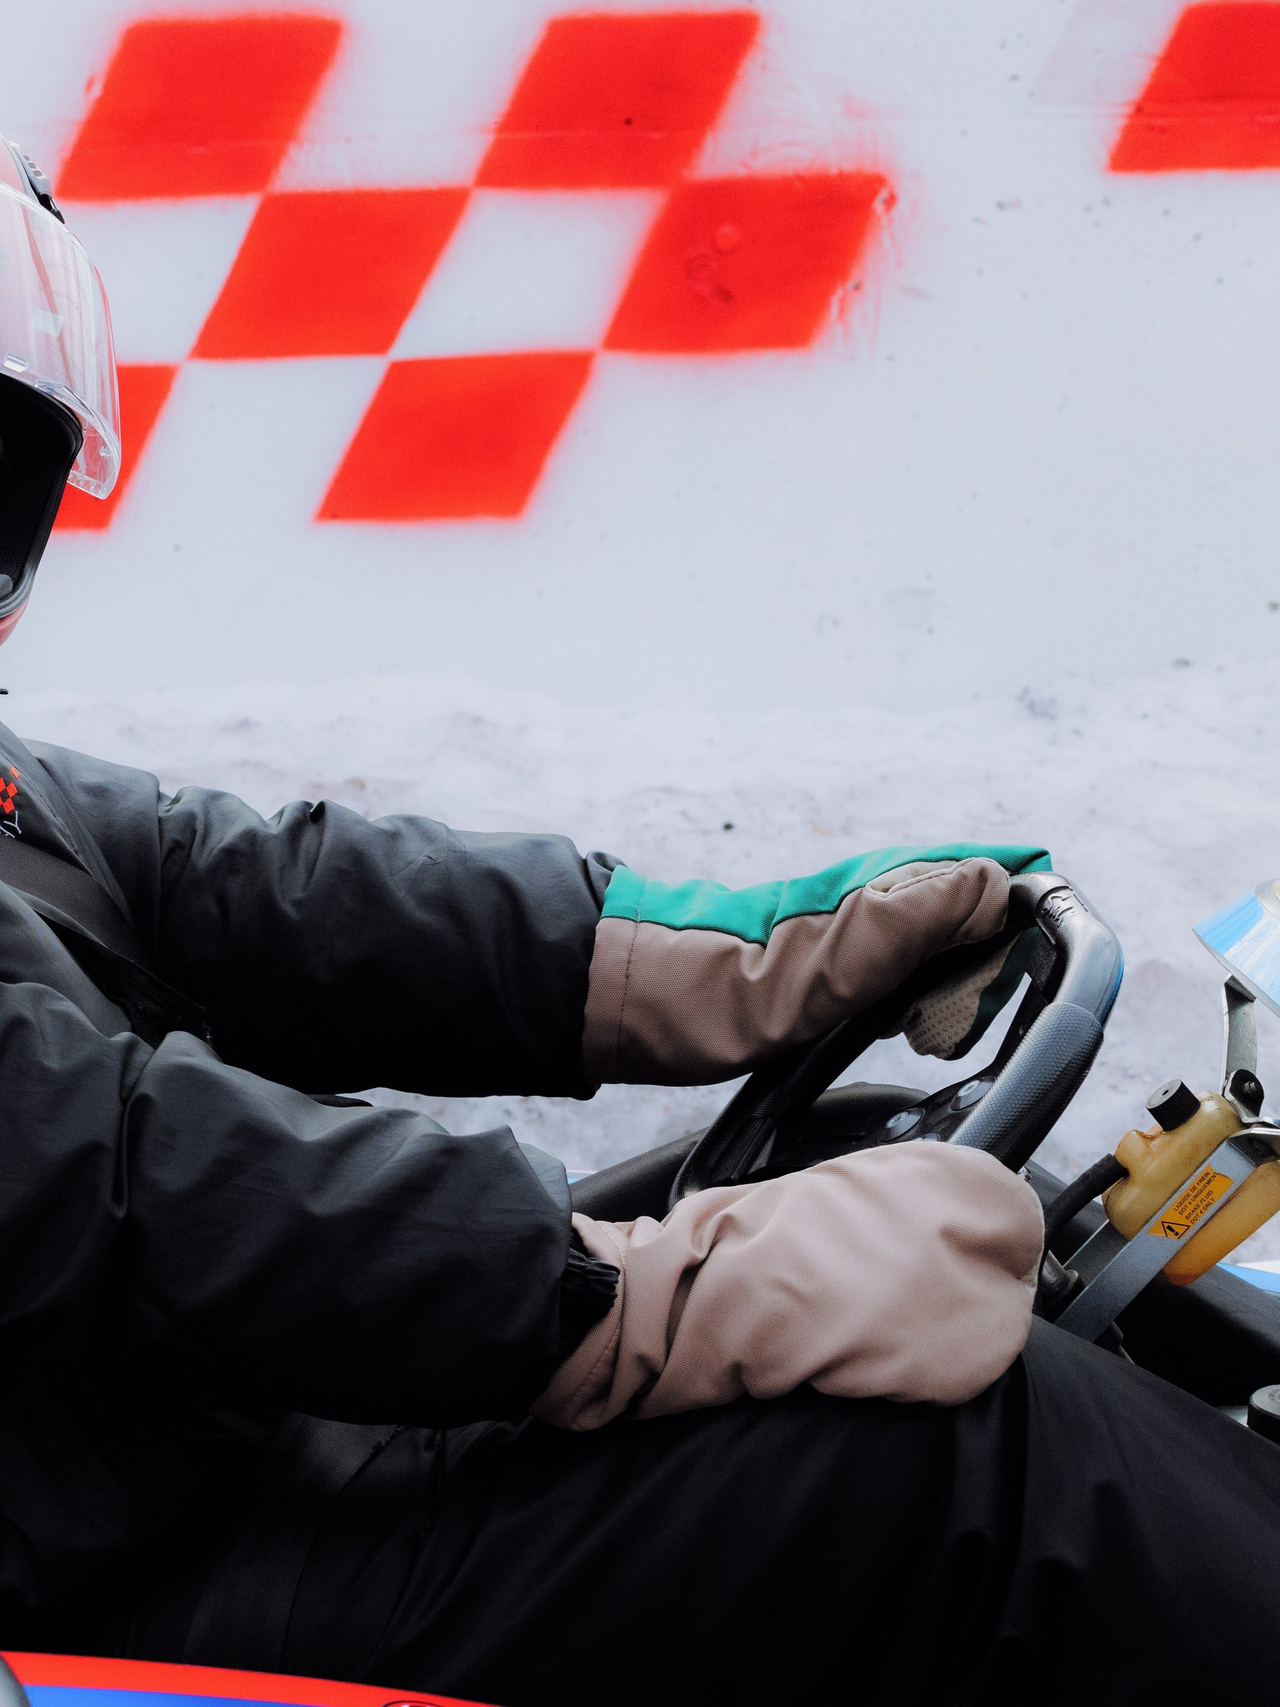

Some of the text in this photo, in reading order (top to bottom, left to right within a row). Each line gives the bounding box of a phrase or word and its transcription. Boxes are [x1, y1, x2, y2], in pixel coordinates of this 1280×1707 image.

[1173, 1192, 1191, 1211] LIQUIDE
[1196, 1171, 1210, 1186] FREIN
[1178, 1205, 1189, 1216] DOT
[1191, 1172, 1219, 1202] UNIQUEMENT
[1185, 1189, 1213, 1220] BRAKE FLUID
[1190, 1213, 1200, 1225] DOT
[1203, 1197, 1215, 1211] ONLY
